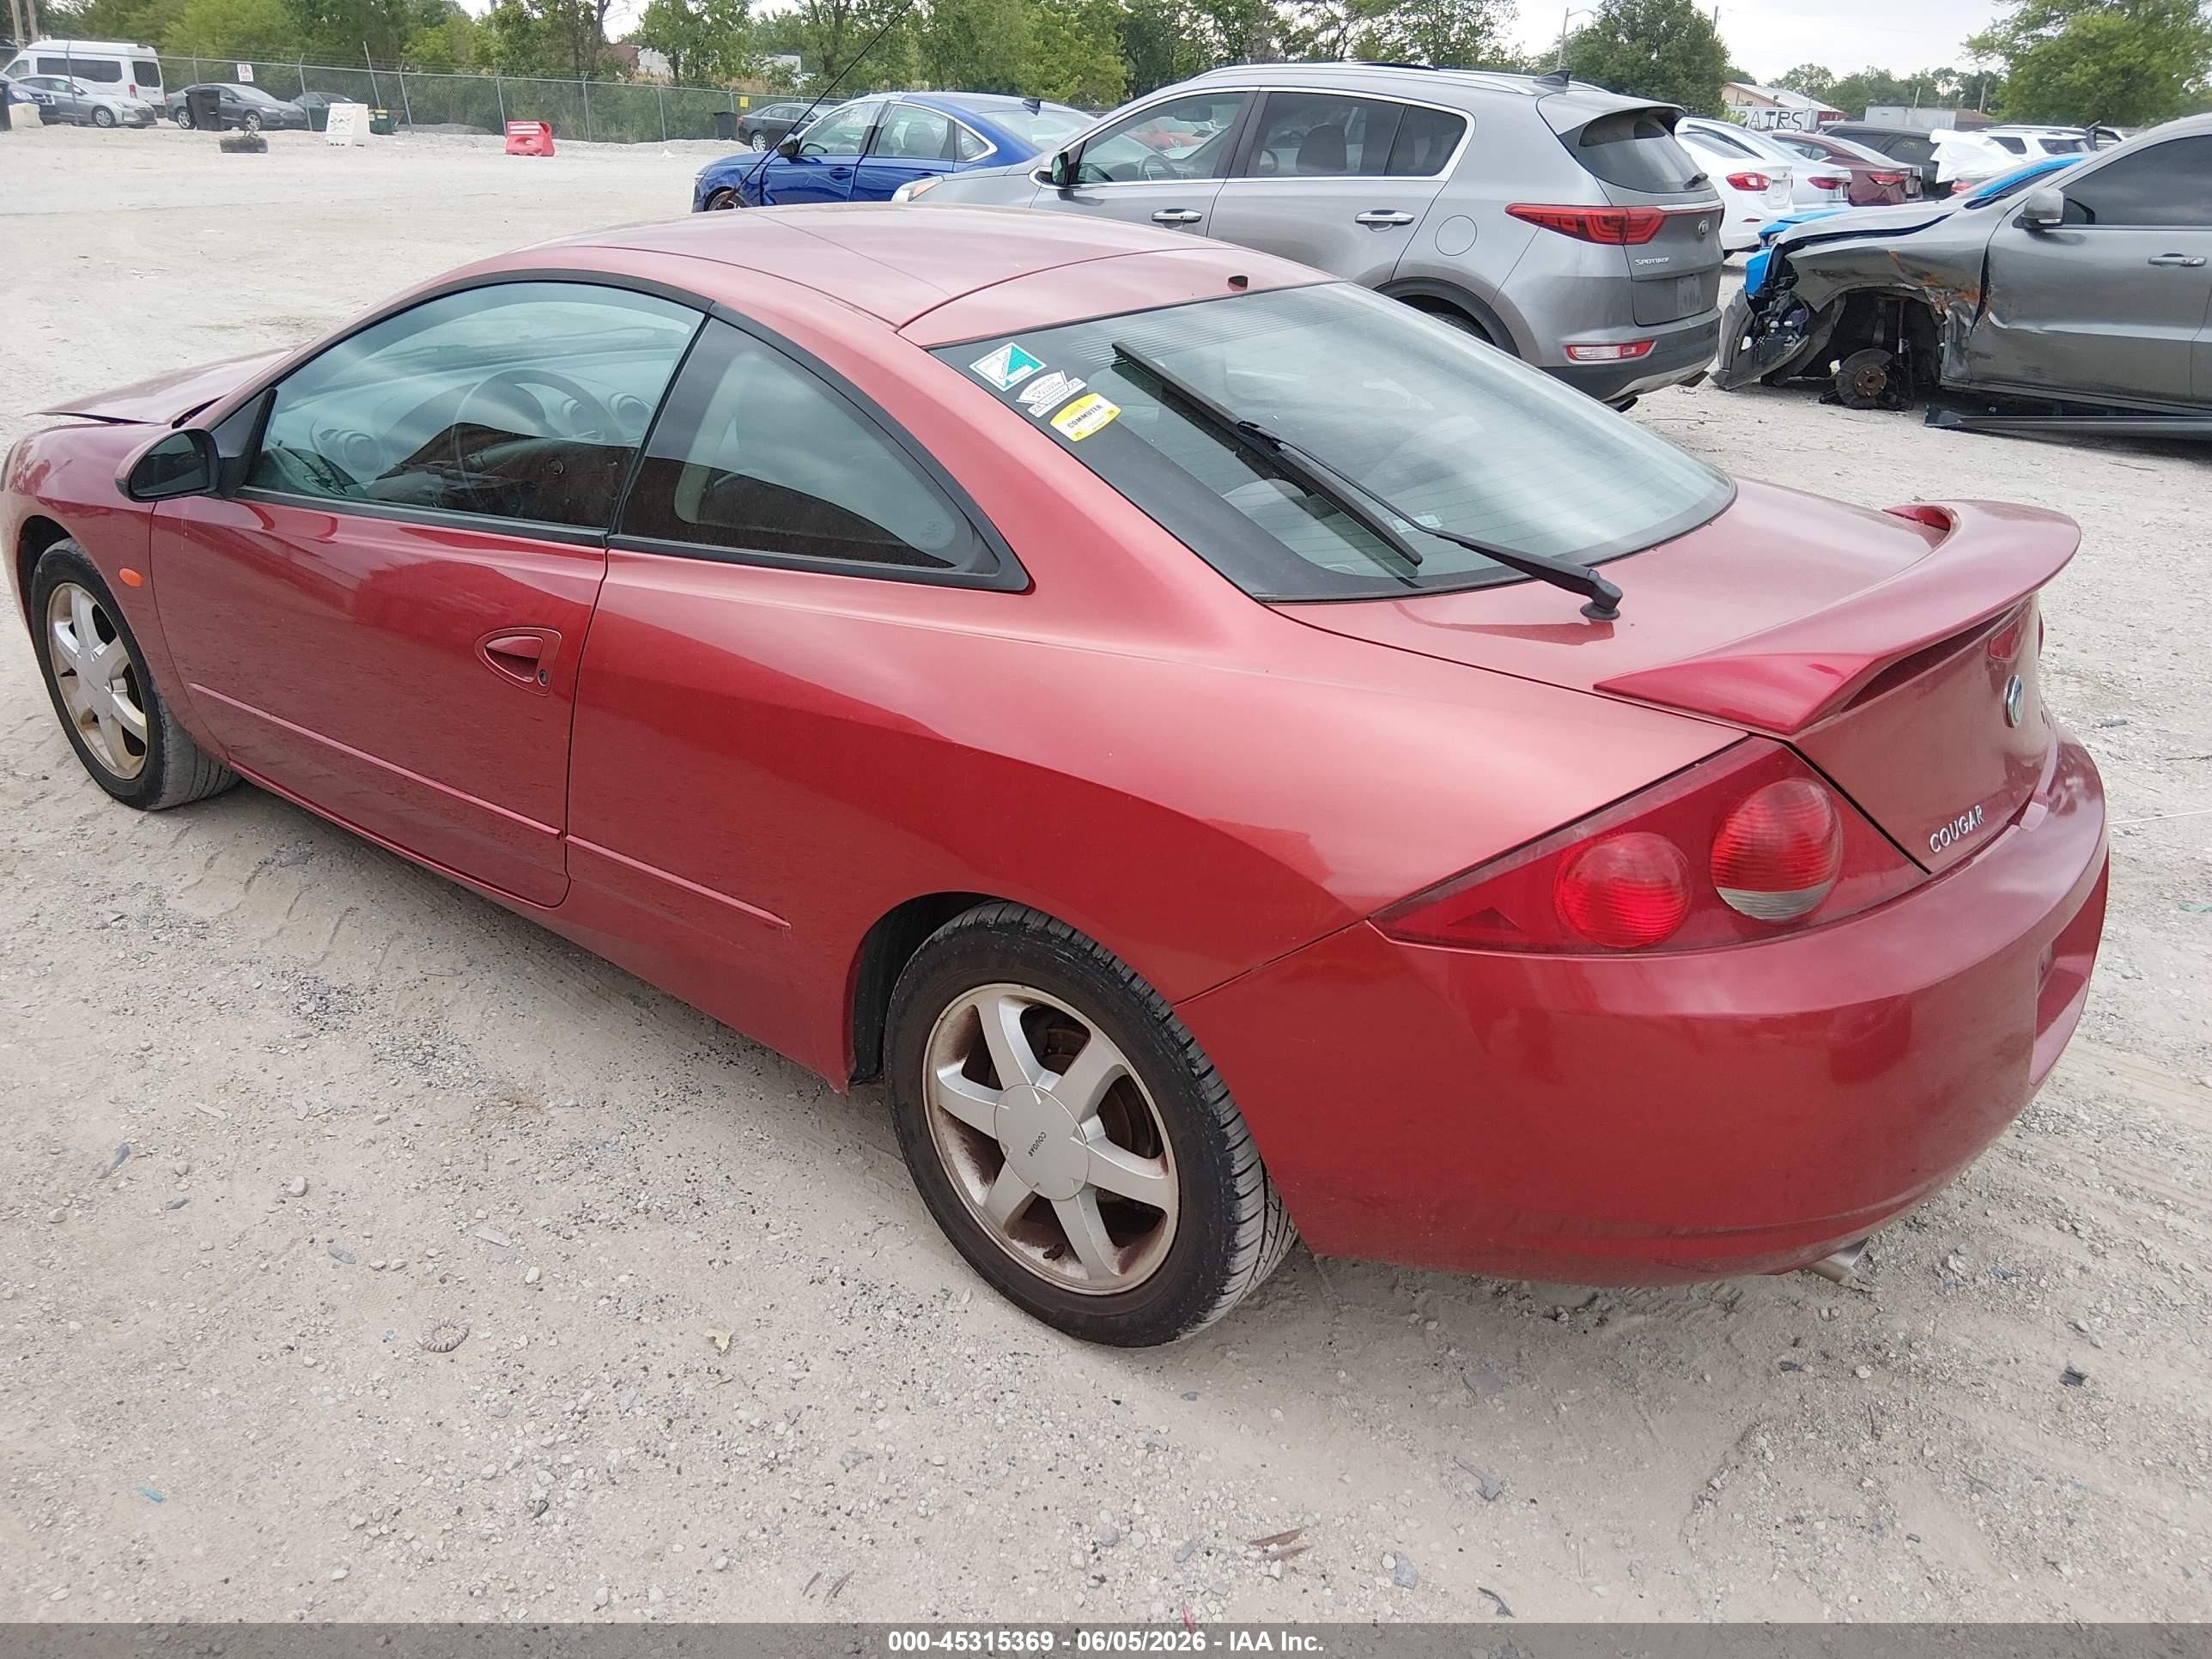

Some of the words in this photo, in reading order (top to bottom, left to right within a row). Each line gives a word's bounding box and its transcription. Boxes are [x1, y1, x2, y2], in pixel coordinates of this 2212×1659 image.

[1066, 404, 1103, 428] COMMUTER
[1929, 805, 1984, 854] COUGAR
[1028, 1132, 1047, 1157] COUGAR
